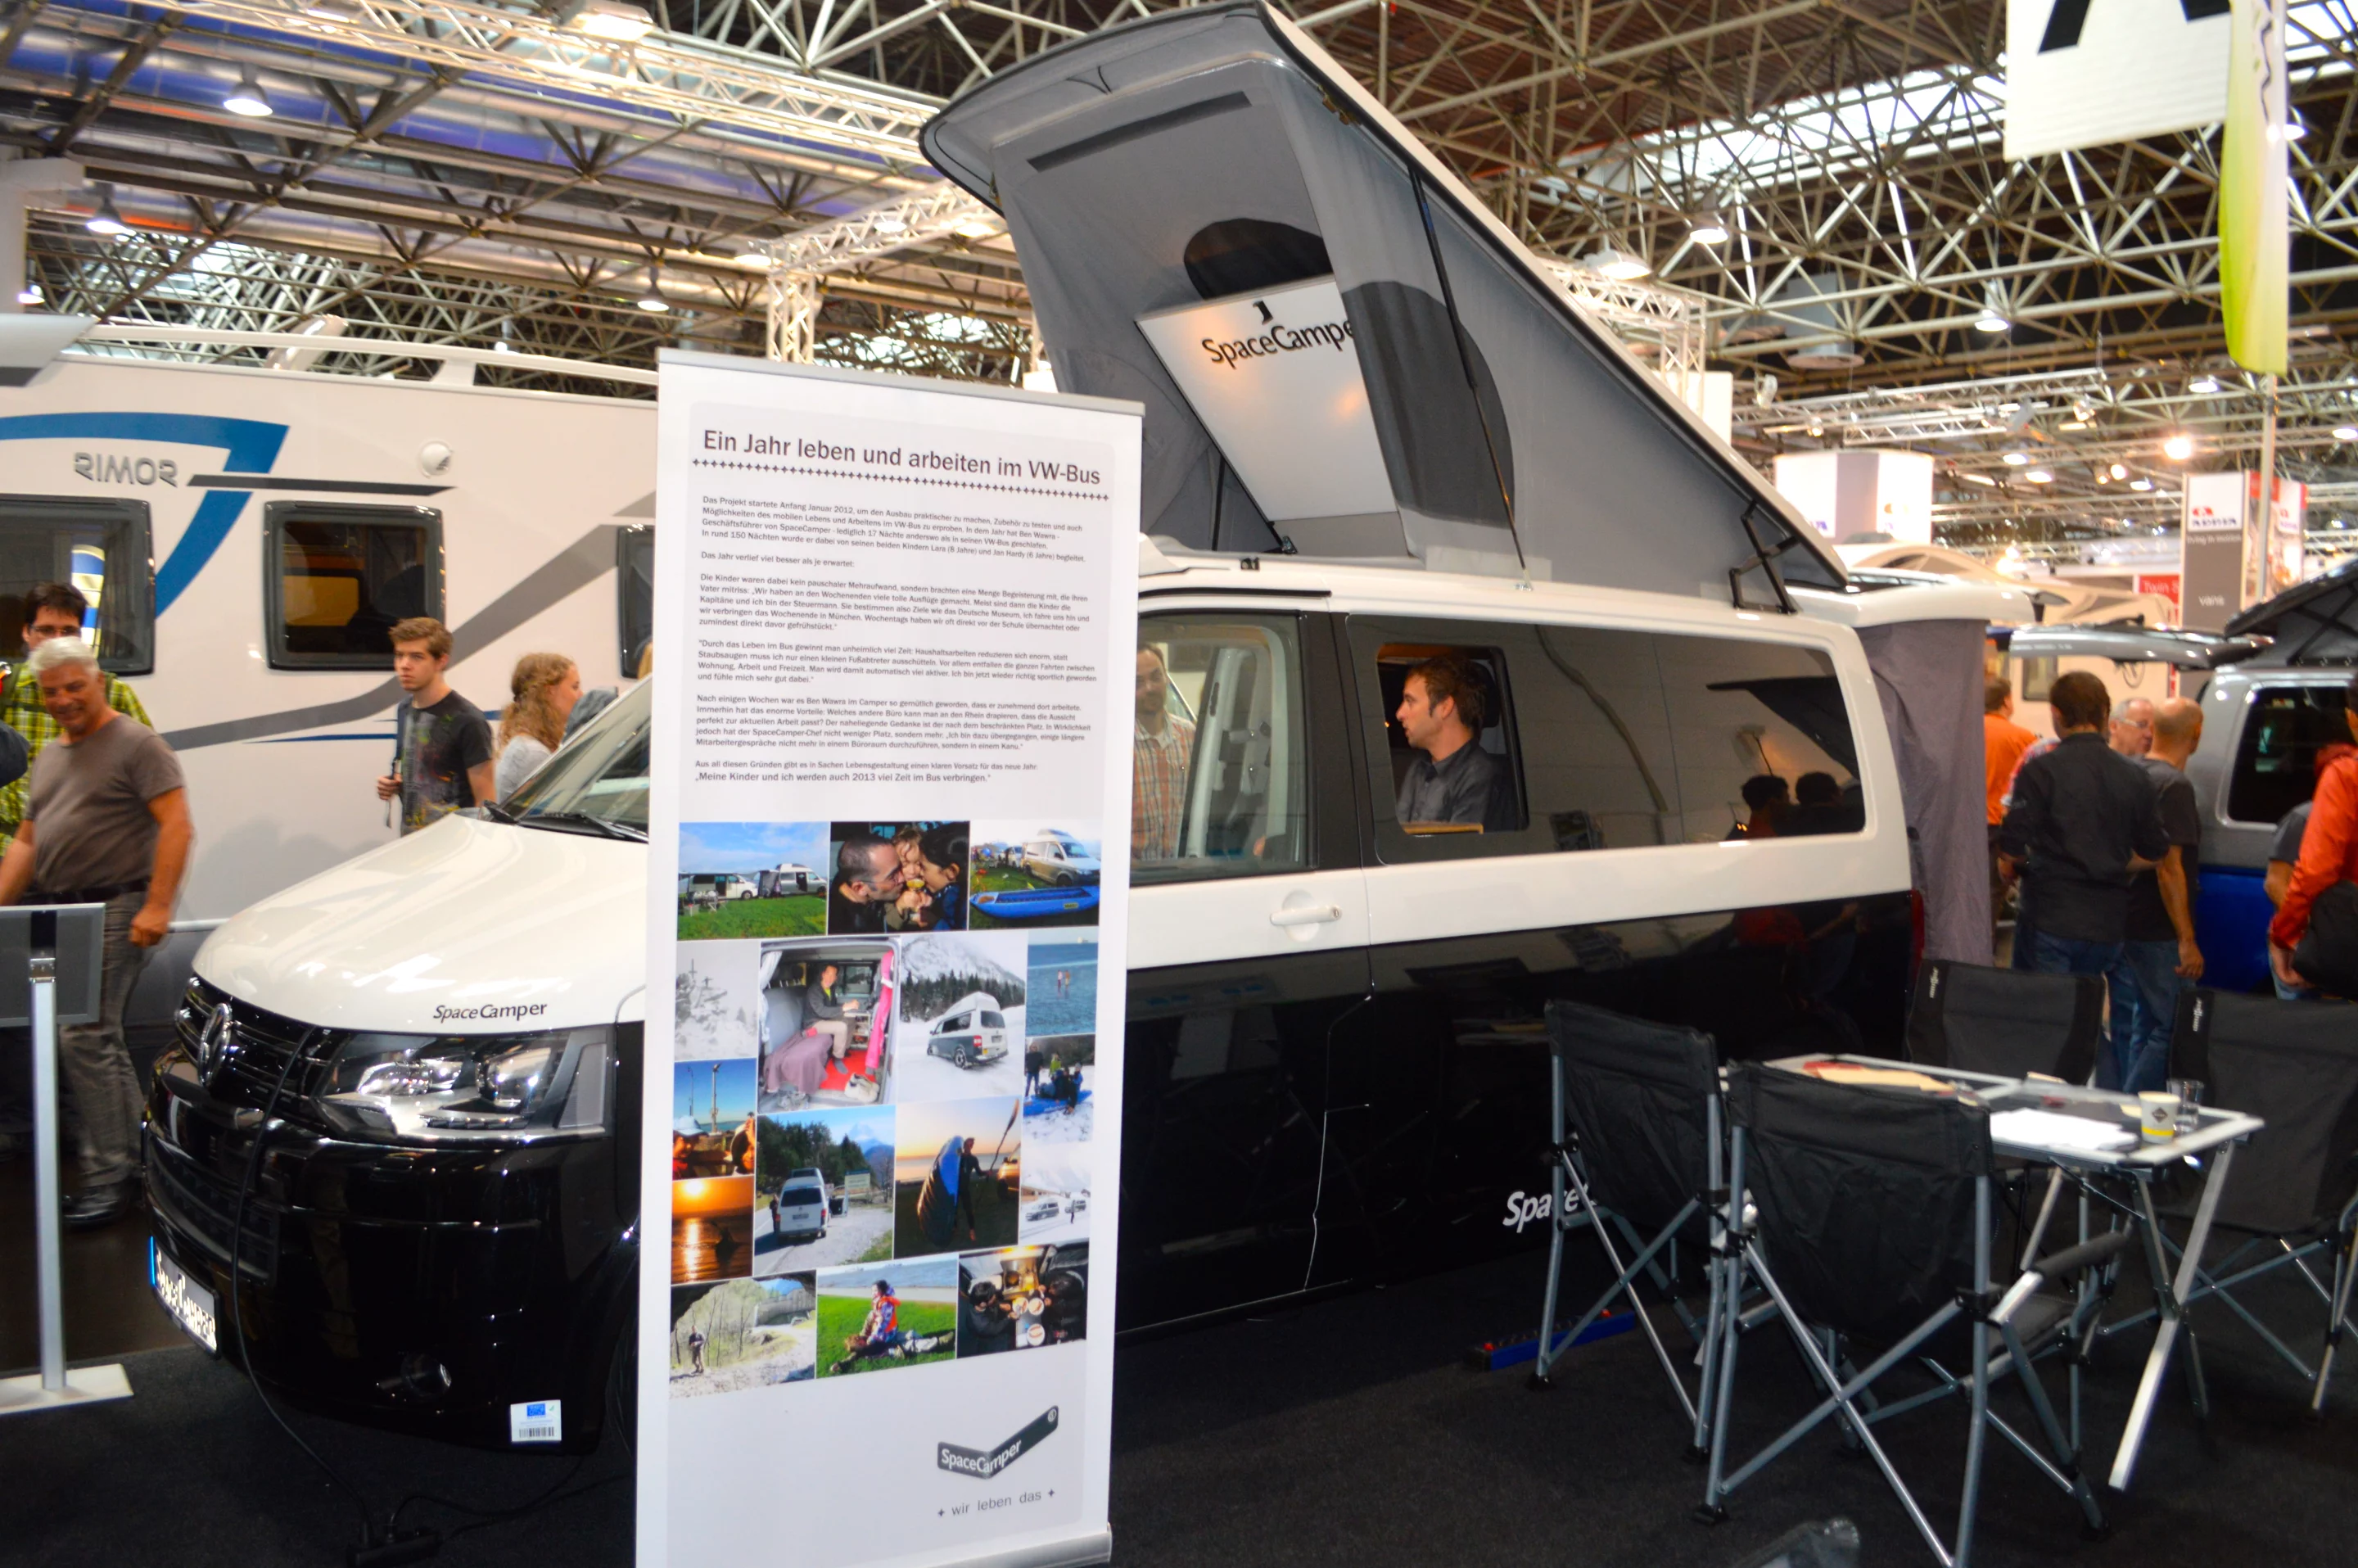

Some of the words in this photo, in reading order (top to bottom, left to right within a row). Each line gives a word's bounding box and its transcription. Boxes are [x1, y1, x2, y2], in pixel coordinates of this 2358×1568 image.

[1201, 319, 1354, 369] SpaceCampe
[704, 430, 737, 452] Ein
[744, 433, 791, 456] Jahr
[798, 438, 856, 462] leben
[863, 447, 901, 466] und
[909, 450, 991, 474] arbeiten
[998, 457, 1022, 477] im
[1028, 460, 1100, 484] VW-Bus
[75, 452, 178, 488] RIMOR
[702, 495, 718, 504] Das
[719, 497, 747, 506] Projekt
[748, 499, 778, 508] startete
[779, 501, 806, 511] Anfang
[808, 504, 832, 512] Januar
[886, 509, 912, 517] Ausbau
[914, 513, 952, 521] praktischer
[747, 531, 779, 540] Nächten
[815, 536, 835, 545] dabei
[876, 540, 901, 549] beiden
[902, 542, 929, 550] Kindern
[956, 546, 978, 555] Jahre)
[775, 555, 801, 563] besser
[815, 558, 821, 566] je
[712, 608, 752, 617] verbringen
[770, 609, 818, 618] Wochenende
[865, 614, 909, 623] Wochentags
[698, 650, 748, 660] Staubsaugen
[775, 675, 787, 683] gut
[718, 695, 747, 703] einigen
[859, 698, 888, 707] Camper
[695, 739, 777, 747] Mitarbeitergespräche
[433, 1004, 548, 1023] SpaceCamper
[942, 1439, 1022, 1473] SpaceCamper
[951, 1503, 970, 1516] wir
[978, 1496, 1012, 1512] leben
[1019, 1491, 1041, 1504] das
